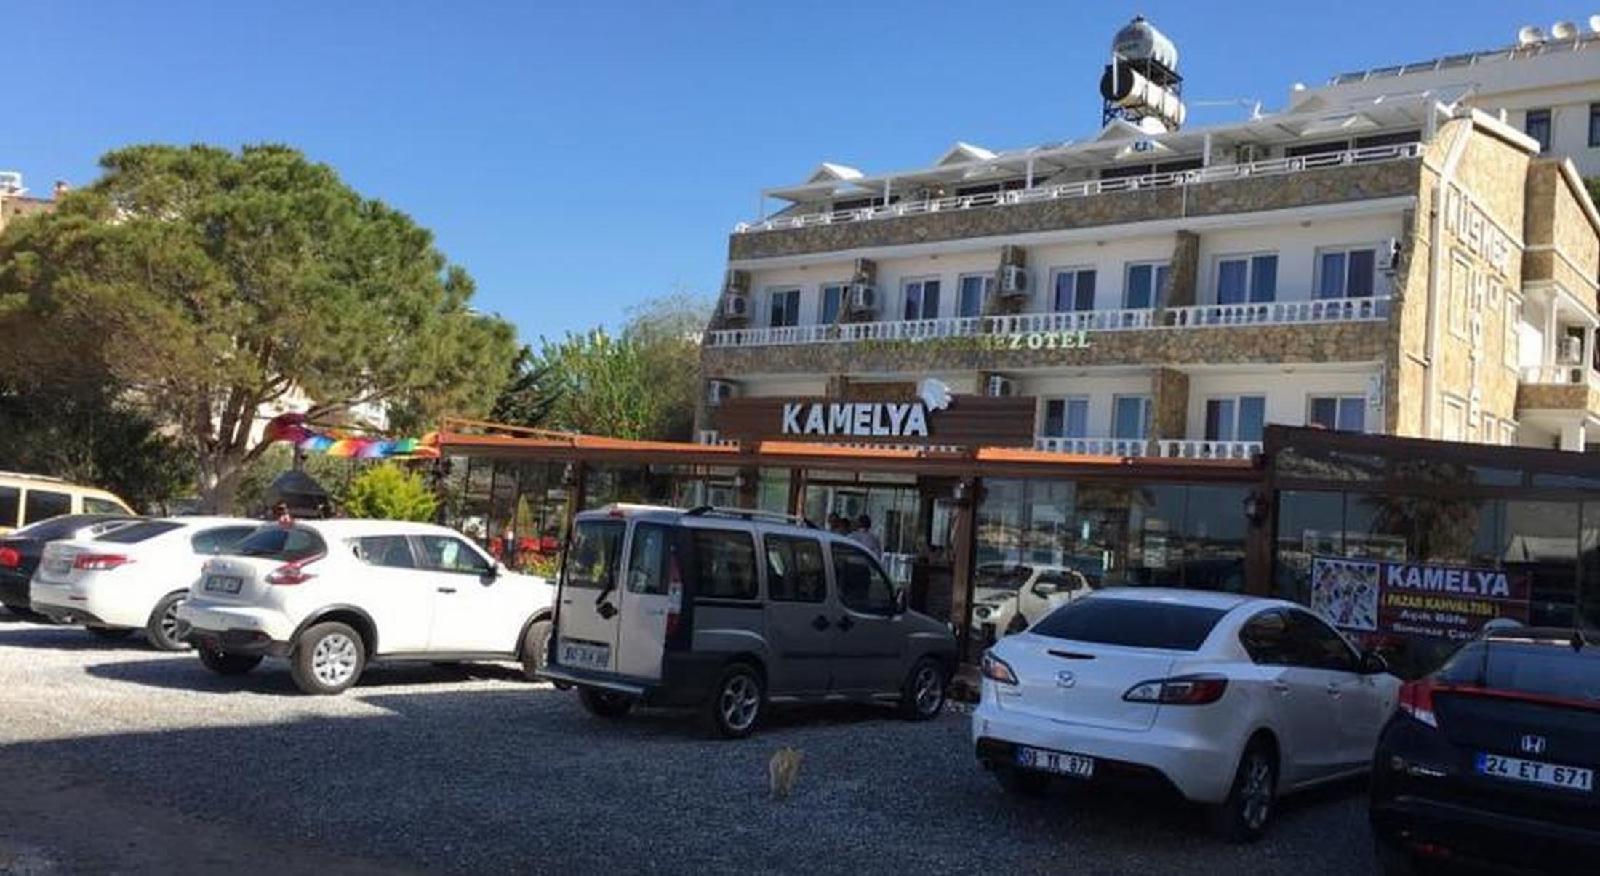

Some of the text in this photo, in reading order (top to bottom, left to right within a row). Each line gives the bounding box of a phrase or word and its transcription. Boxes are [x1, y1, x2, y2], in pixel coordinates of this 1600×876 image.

[781, 402, 928, 437] KAMELYA
[1386, 565, 1510, 597] KAMELYA
[1486, 757, 1589, 787] 24 ET 671
